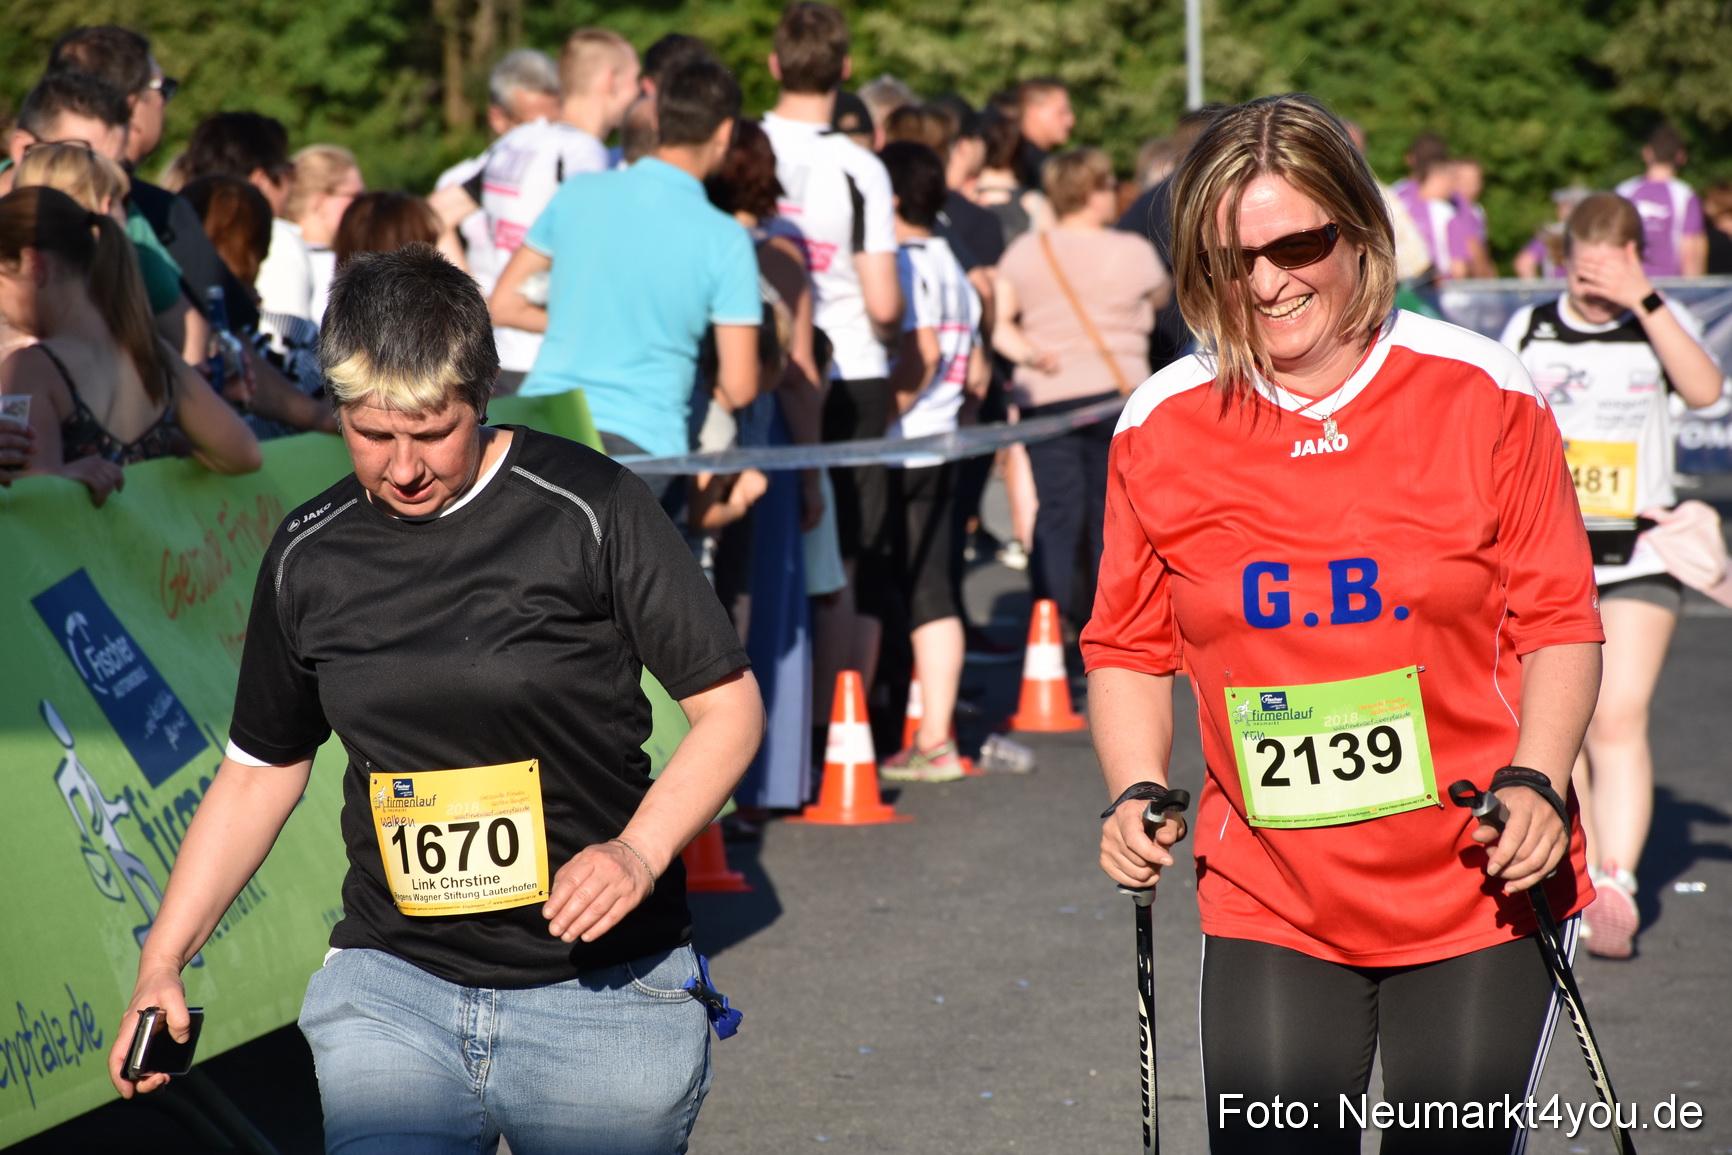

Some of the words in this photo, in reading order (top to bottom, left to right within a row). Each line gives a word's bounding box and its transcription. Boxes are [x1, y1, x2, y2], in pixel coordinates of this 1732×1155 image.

[1290, 434, 1349, 458] JAKO
[302, 502, 332, 524] JAKO
[1242, 557, 1410, 630] G.B.
[84, 634, 136, 682] Fischer
[1252, 707, 1313, 721] firmenlauf
[1324, 712, 1358, 727] 2018
[1256, 725, 1403, 788] 2139
[387, 794, 437, 808] firmenlauf
[446, 802, 479, 816] 2018
[380, 815, 416, 828] walken
[391, 817, 520, 875] 1670
[411, 878, 437, 891] Link
[440, 874, 501, 889] Chrstine
[413, 893, 442, 904] Wagner
[443, 890, 481, 902] Stiftung
[482, 881, 538, 897] Lauterhofen
